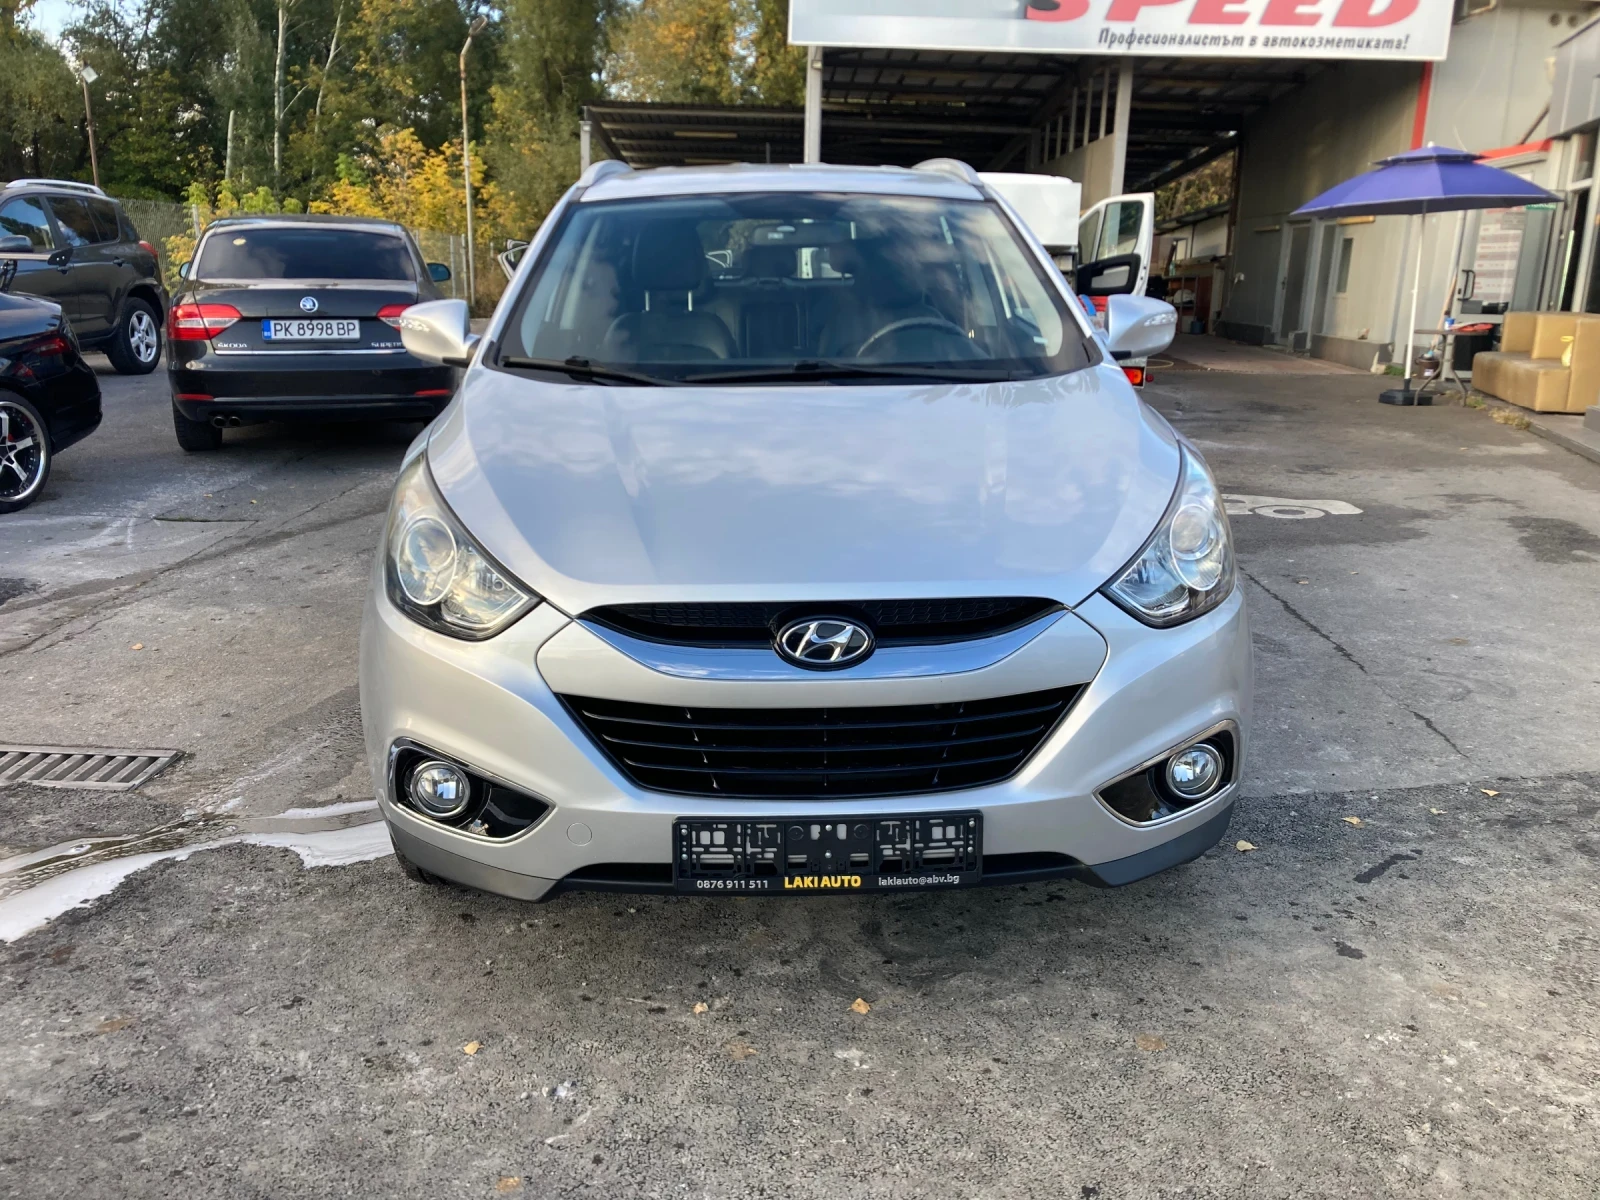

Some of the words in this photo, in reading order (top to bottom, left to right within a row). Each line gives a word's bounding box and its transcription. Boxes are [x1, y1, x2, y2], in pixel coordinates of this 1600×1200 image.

[1098, 27, 1244, 49] Професионалистът
[1249, 36, 1258, 47] в
[1263, 34, 1411, 50] автокозметиката!
[273, 322, 294, 337] PK
[297, 322, 334, 336] 8998
[336, 321, 356, 336] BP
[696, 880, 725, 889] 0876
[726, 880, 746, 889] 911
[748, 880, 768, 888] 511
[784, 876, 819, 889] LAKI
[820, 875, 862, 888] AUTO
